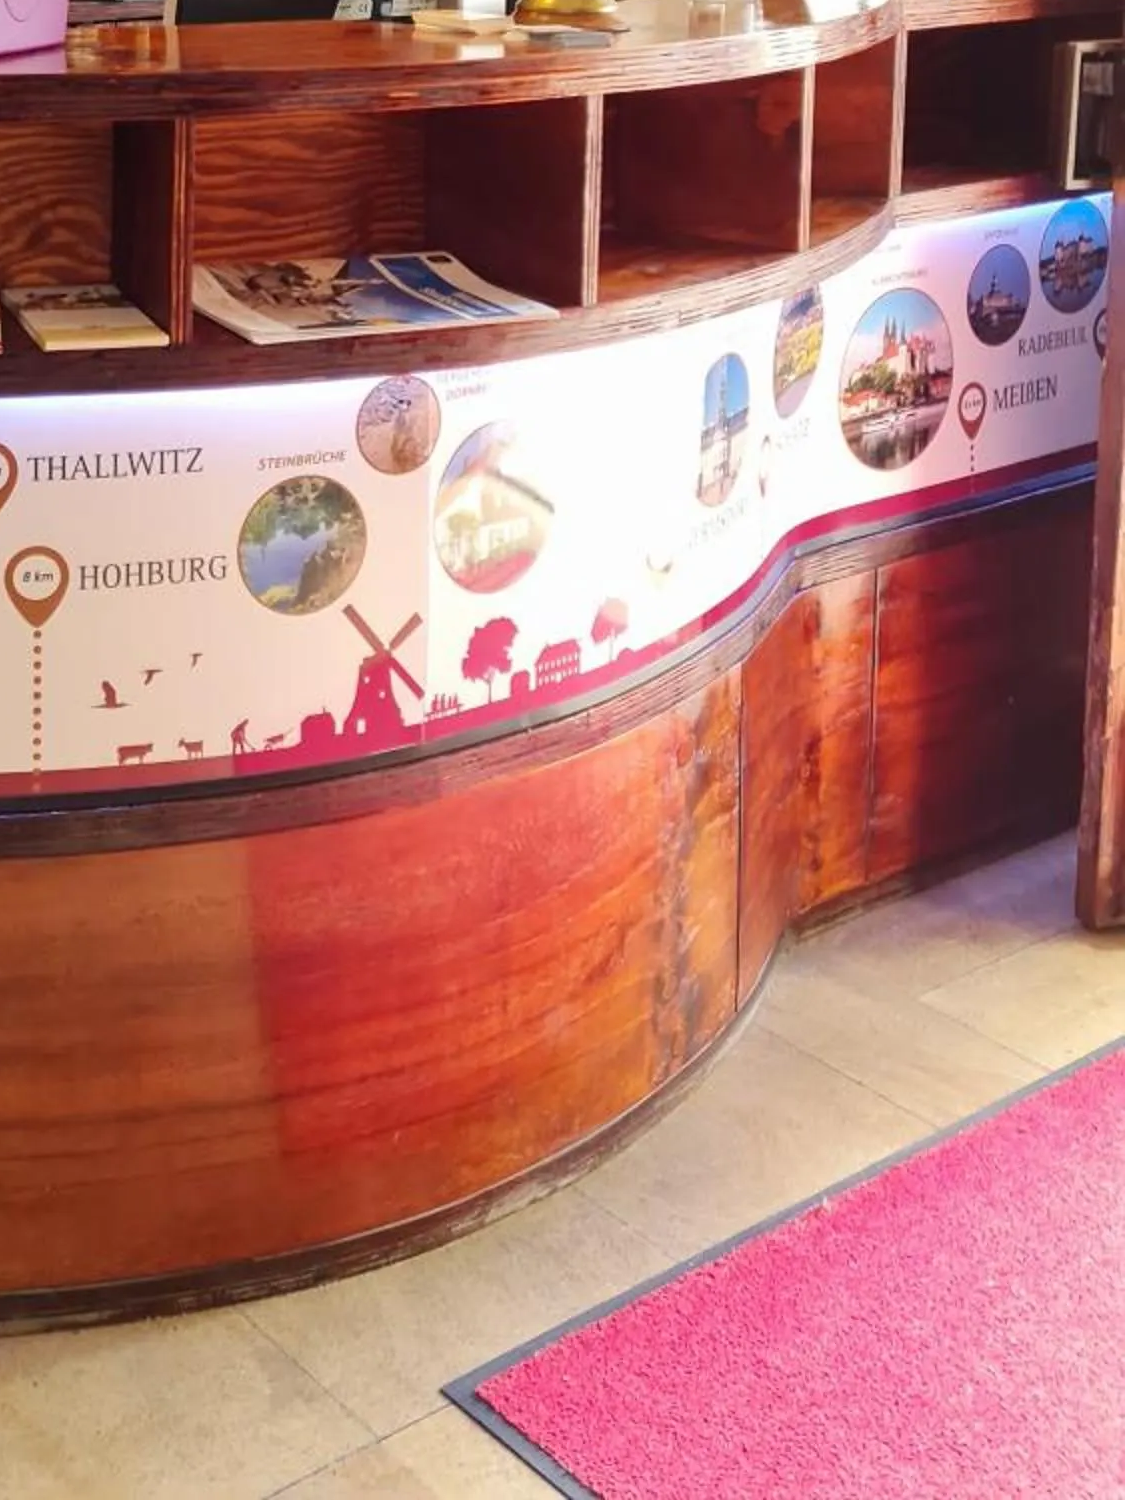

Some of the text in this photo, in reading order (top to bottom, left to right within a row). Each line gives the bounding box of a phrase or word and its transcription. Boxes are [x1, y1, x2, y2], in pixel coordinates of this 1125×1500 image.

[27, 447, 204, 482] THALLWITZ
[257, 449, 348, 471] STEINBRÜCHE
[34, 569, 54, 583] km
[79, 554, 228, 592] HOHBURG
